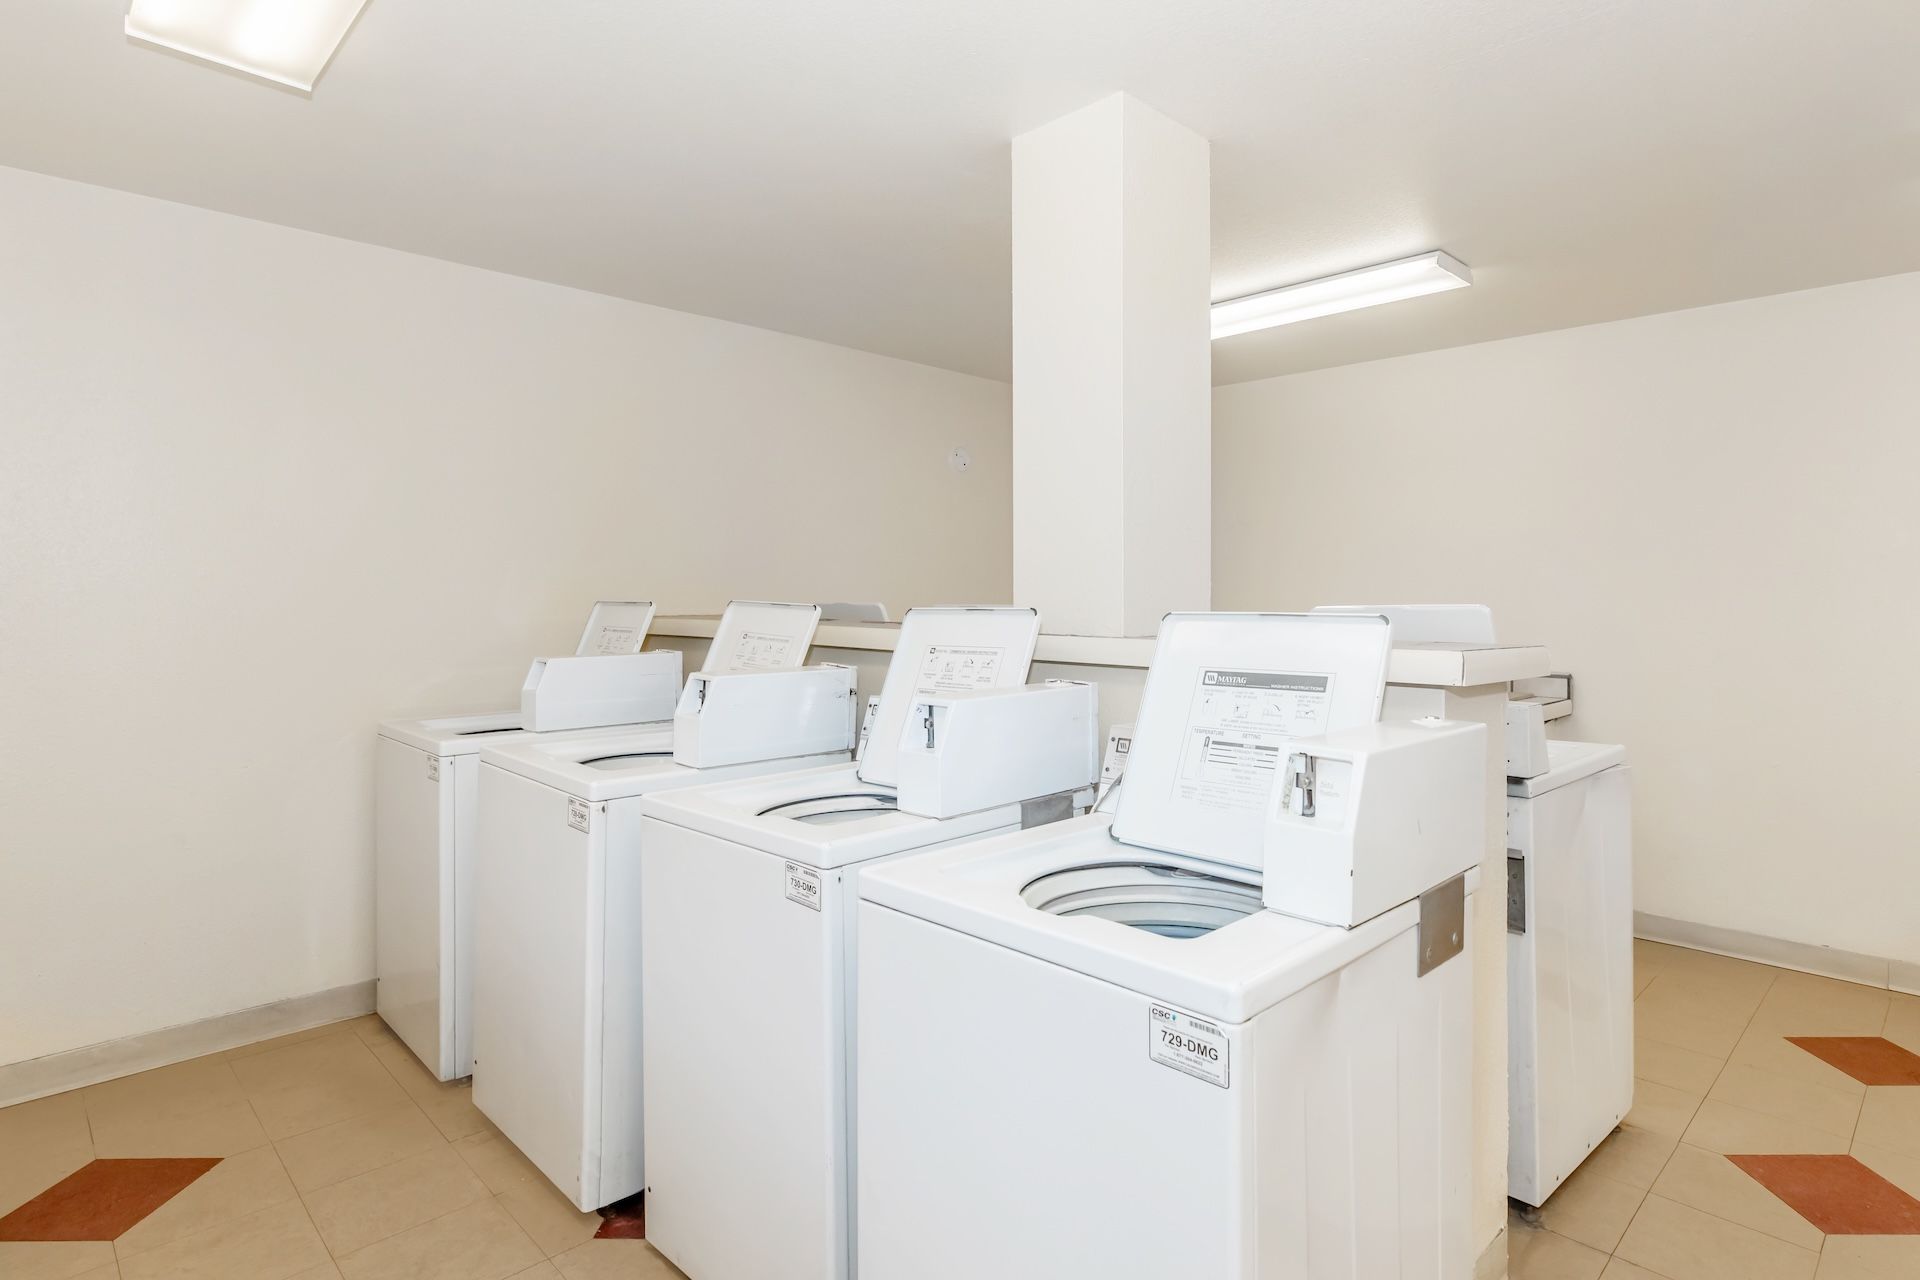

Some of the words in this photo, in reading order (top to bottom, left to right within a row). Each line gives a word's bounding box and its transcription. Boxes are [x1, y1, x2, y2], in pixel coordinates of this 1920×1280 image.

[1217, 675, 1247, 684] MAYTAG
[1194, 728, 1225, 737] TEMPERATURE
[1242, 732, 1262, 740] SETTING
[790, 877, 817, 895] 730-DMG
[1151, 1007, 1171, 1020] CSC
[1160, 1029, 1219, 1061] 729-DMG
